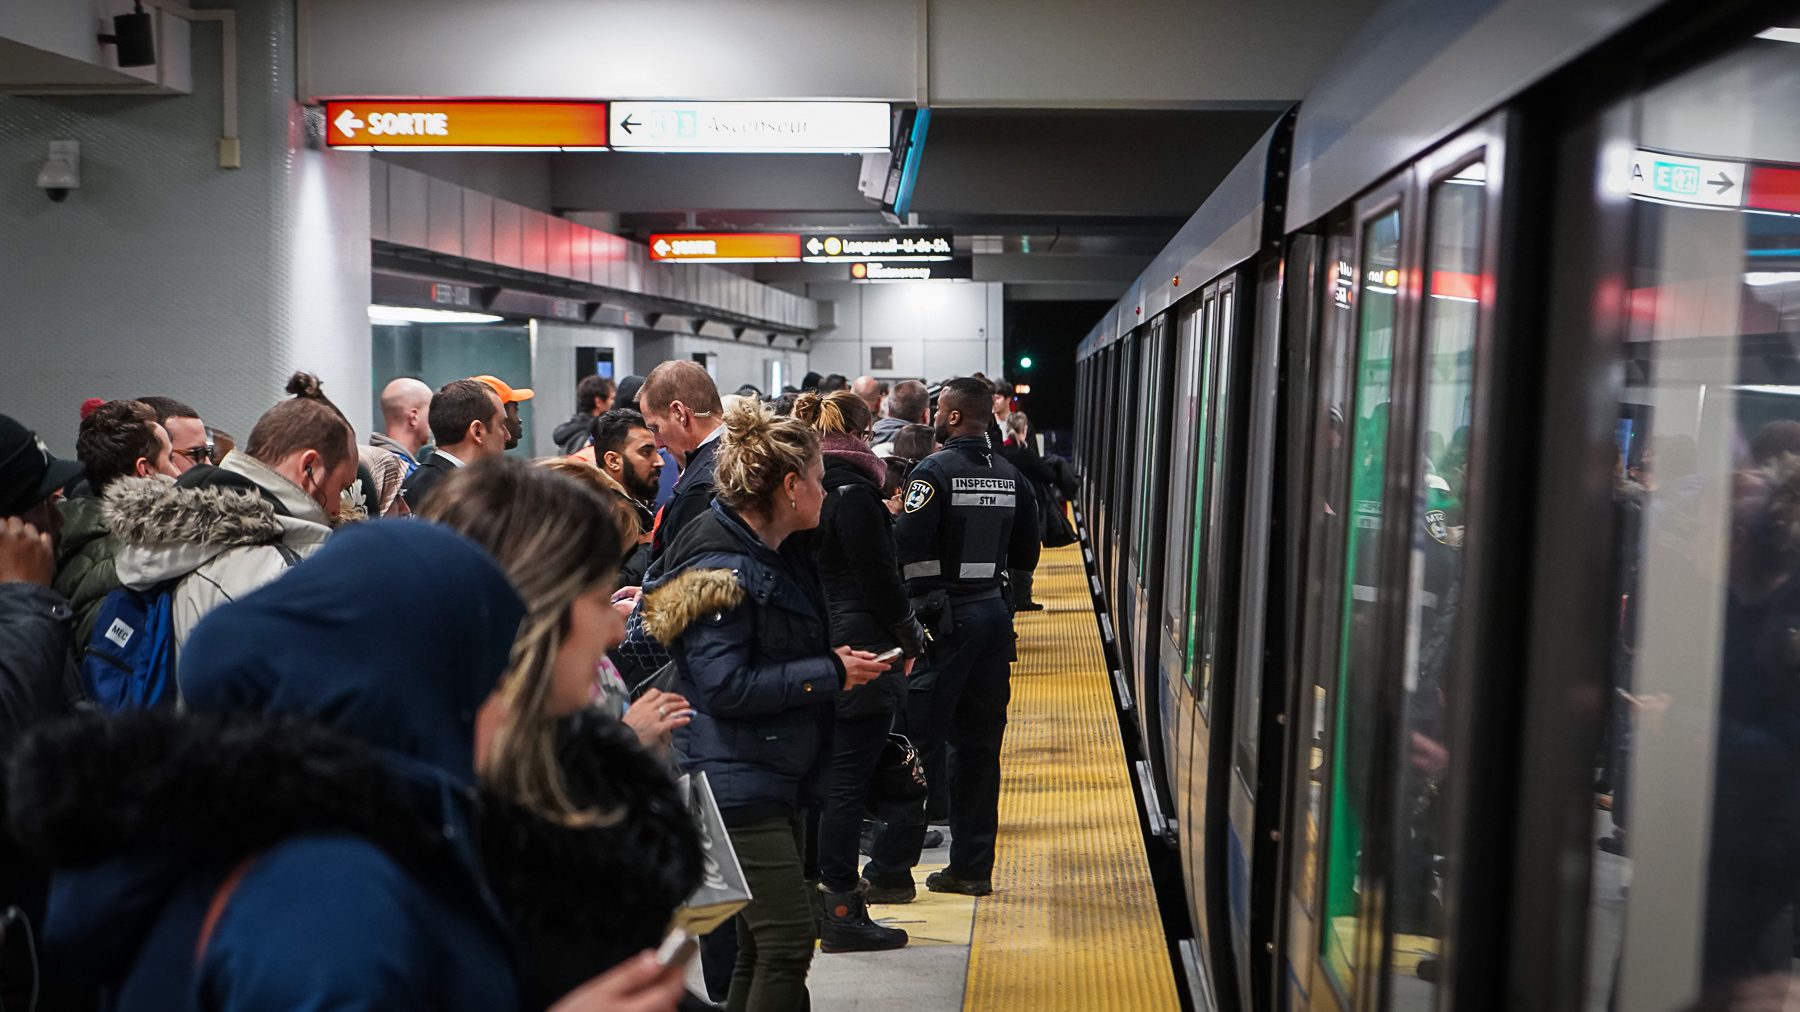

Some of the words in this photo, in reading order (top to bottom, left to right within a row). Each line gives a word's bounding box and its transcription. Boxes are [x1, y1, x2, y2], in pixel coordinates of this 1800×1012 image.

[367, 112, 449, 136] SORTIE
[911, 482, 931, 494] STM
[955, 479, 1016, 490] INSPECTEUR
[979, 496, 997, 505] STM
[111, 624, 129, 641] MEC
